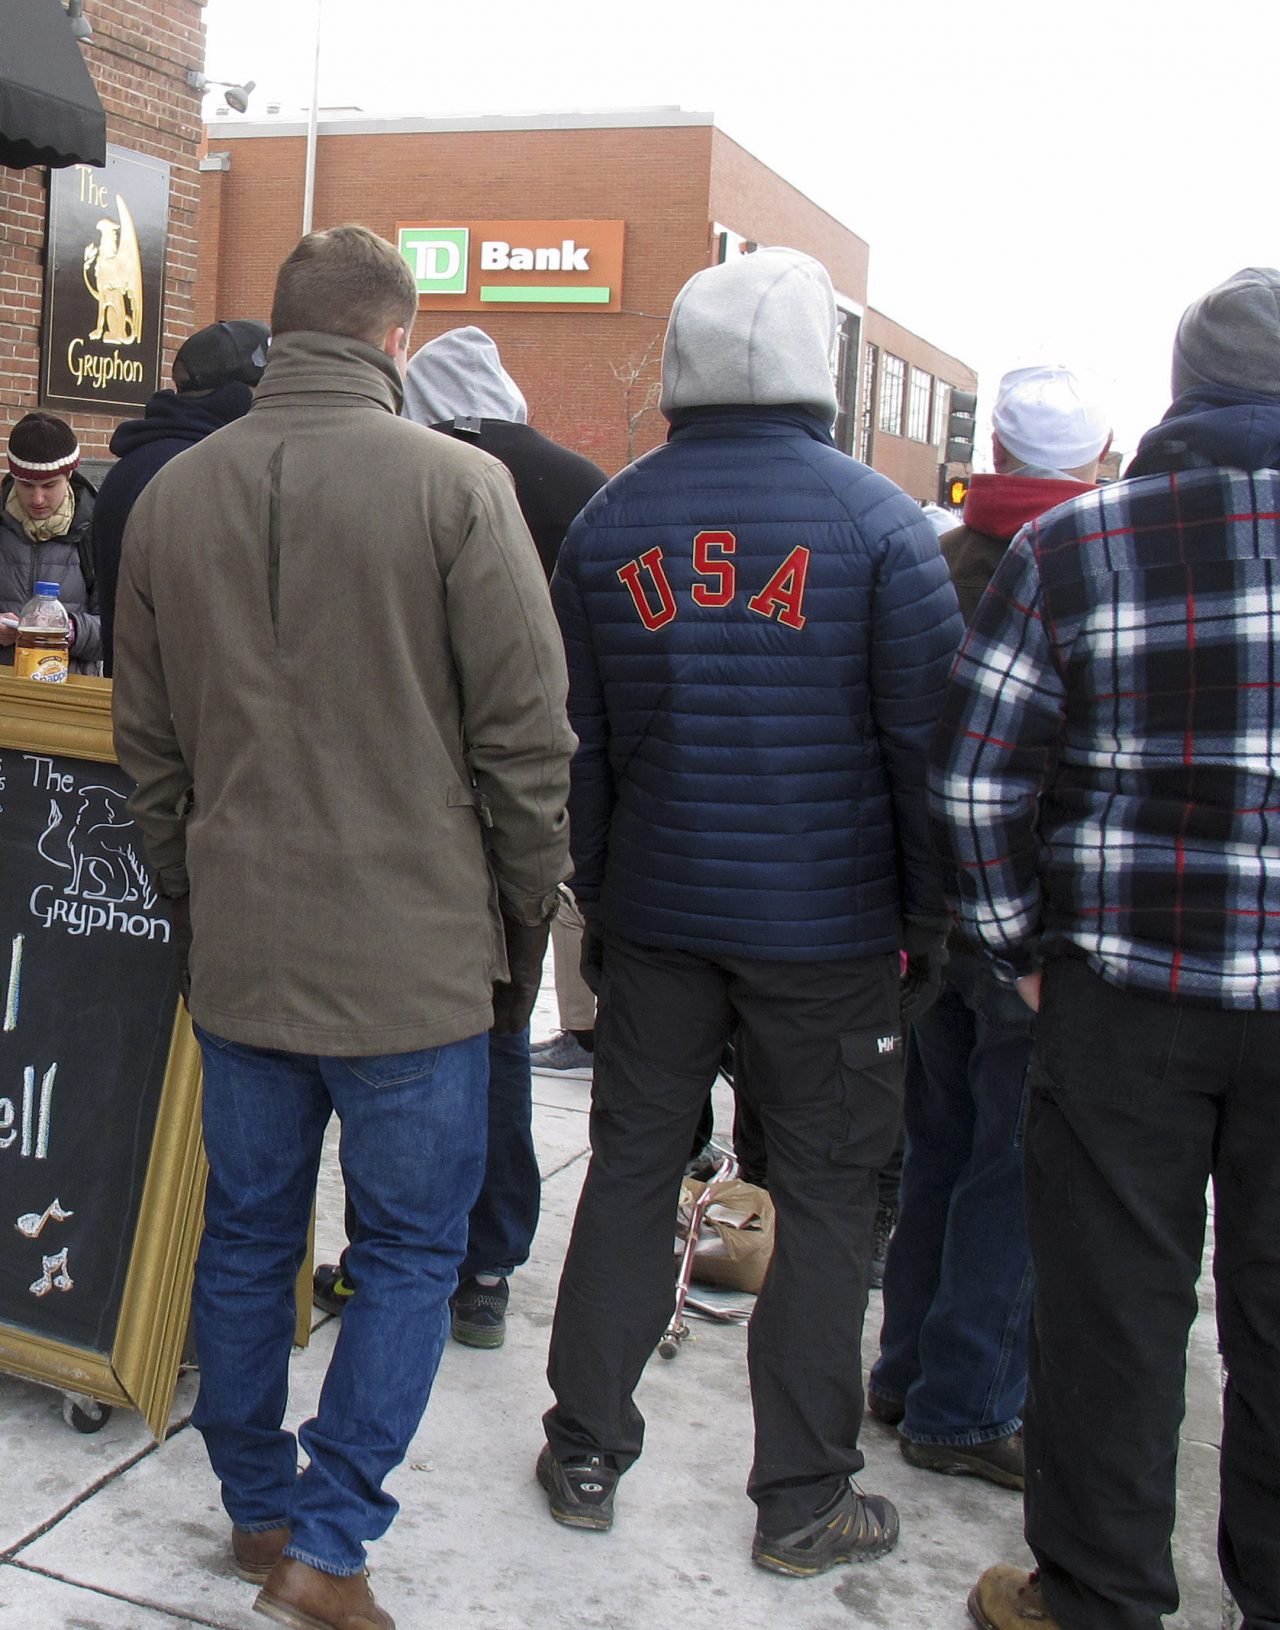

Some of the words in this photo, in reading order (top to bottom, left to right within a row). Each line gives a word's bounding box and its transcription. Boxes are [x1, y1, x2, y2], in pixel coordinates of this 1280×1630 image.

[75, 164, 109, 209] The
[405, 240, 461, 280] TD
[480, 239, 590, 271] Bank
[616, 530, 810, 632] USA
[23, 754, 74, 793] The
